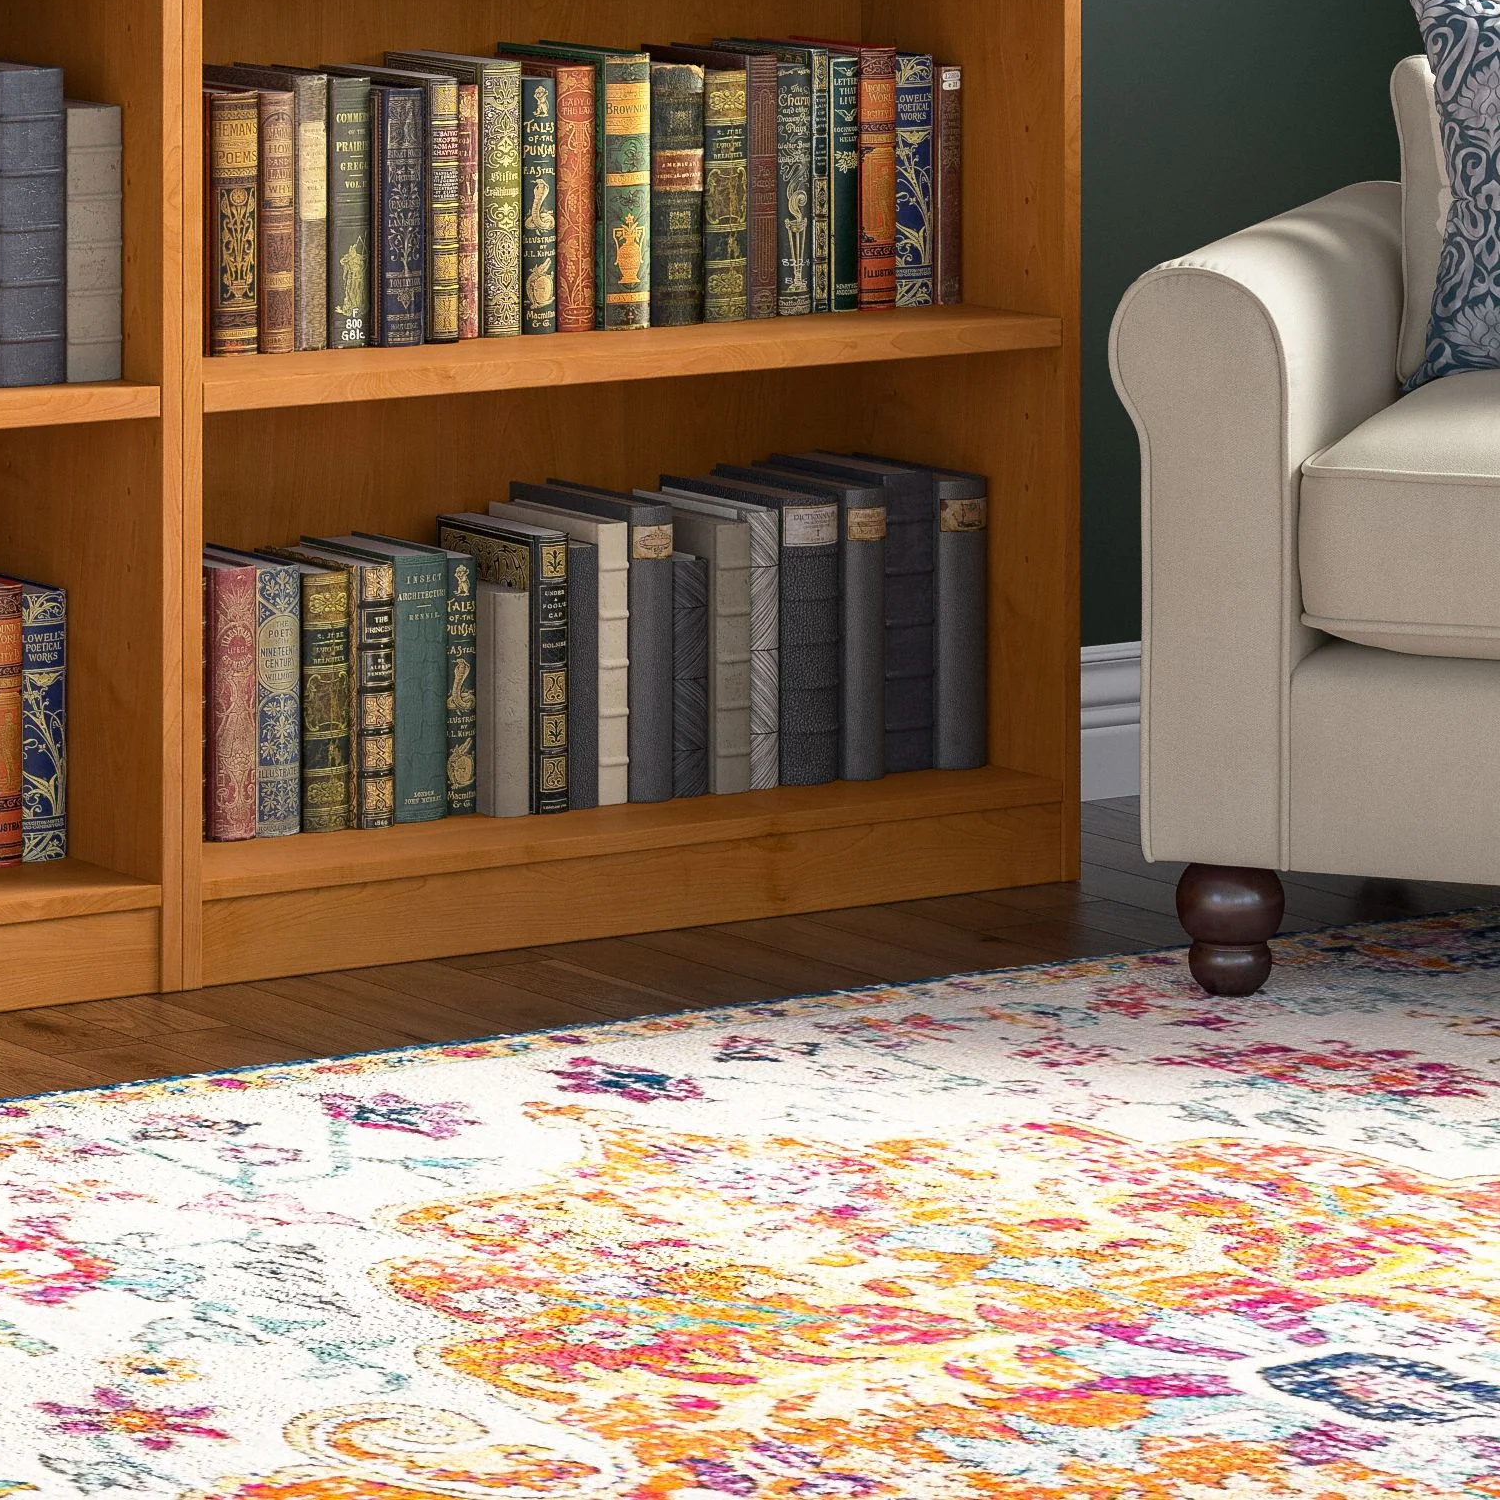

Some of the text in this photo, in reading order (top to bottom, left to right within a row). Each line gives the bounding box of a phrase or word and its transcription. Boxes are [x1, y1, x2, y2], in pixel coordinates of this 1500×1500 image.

[839, 87, 857, 95] THAT
[778, 93, 810, 106] Charm
[839, 96, 857, 105] LIVE
[782, 106, 795, 114] and
[897, 102, 930, 112] POETICAL
[900, 111, 927, 122] WORKS
[214, 121, 257, 137] HEMANS
[523, 121, 554, 133] TALES
[785, 123, 807, 134] Plays
[268, 143, 290, 153] HOW
[216, 150, 257, 165] POEMS
[272, 158, 289, 166] AND
[661, 161, 699, 169] AMERICAN
[269, 169, 292, 179] LADY
[268, 184, 292, 194] WHY
[352, 308, 358, 316] F
[345, 319, 363, 329] 800
[406, 572, 443, 585] INSECT
[447, 598, 476, 613] TALES
[542, 601, 567, 609] FOOL'S
[373, 615, 389, 623] THE
[22, 630, 65, 643] LOWELL'S
[268, 628, 294, 638] POETS
[25, 641, 62, 653] POETICAL
[455, 645, 476, 657] STEEL
[28, 651, 58, 663] WORKS
[264, 659, 295, 668] CENTURY
